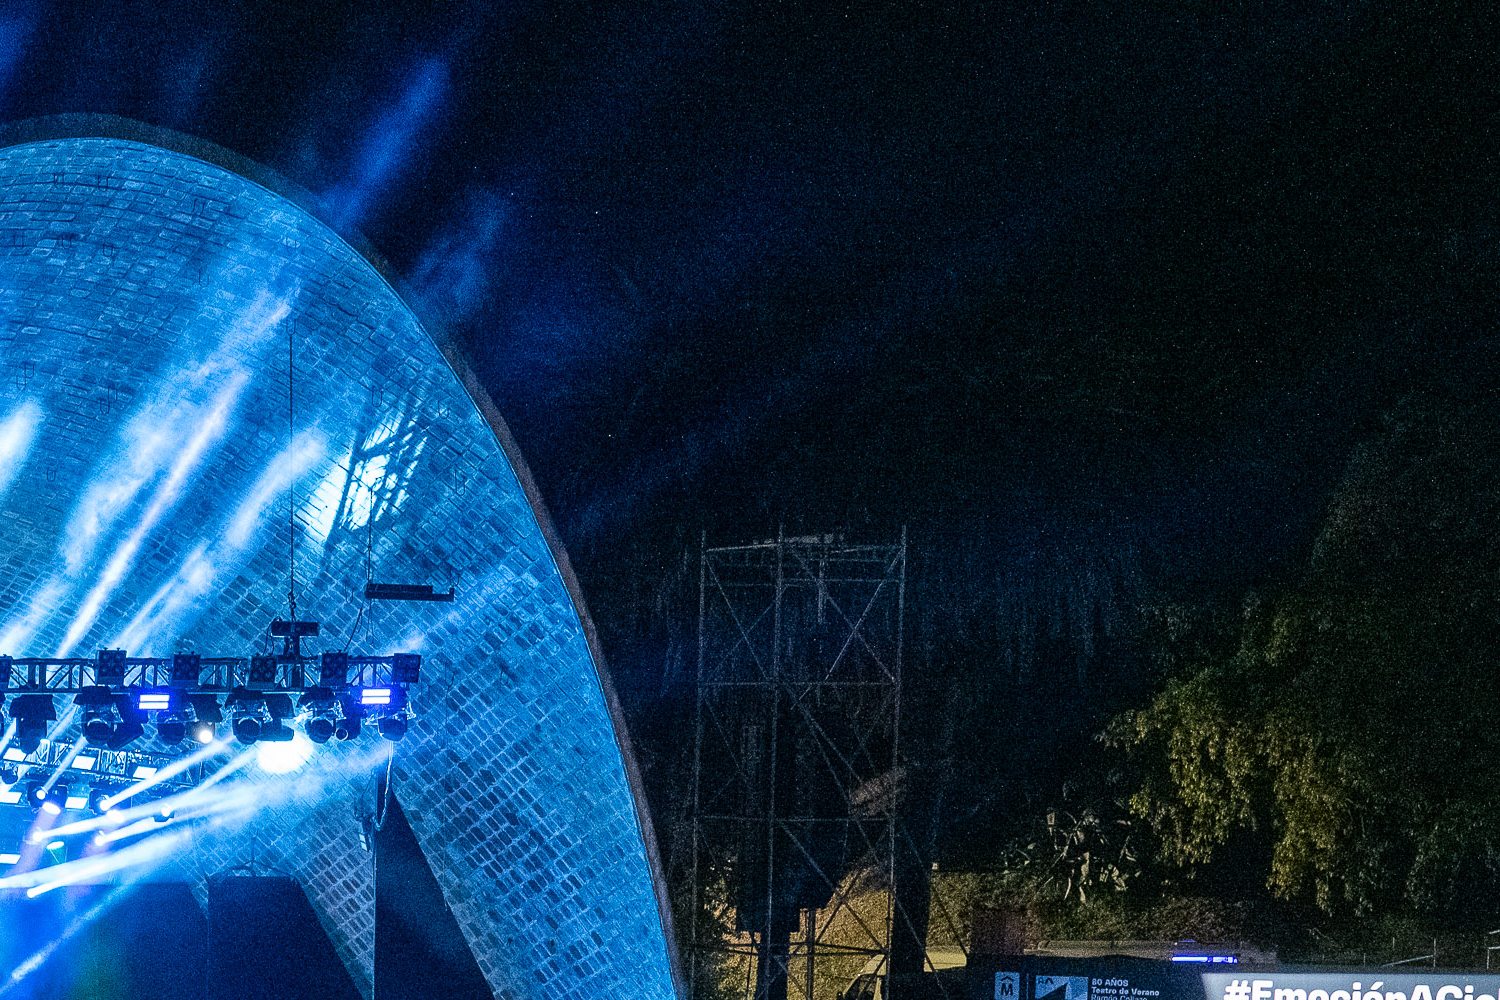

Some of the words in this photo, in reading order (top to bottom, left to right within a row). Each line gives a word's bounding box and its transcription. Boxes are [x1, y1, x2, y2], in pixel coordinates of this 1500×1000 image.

[1104, 977, 1129, 987] AÑOS
[1091, 986, 1117, 994] Teatro
[1131, 988, 1160, 996] Verano
